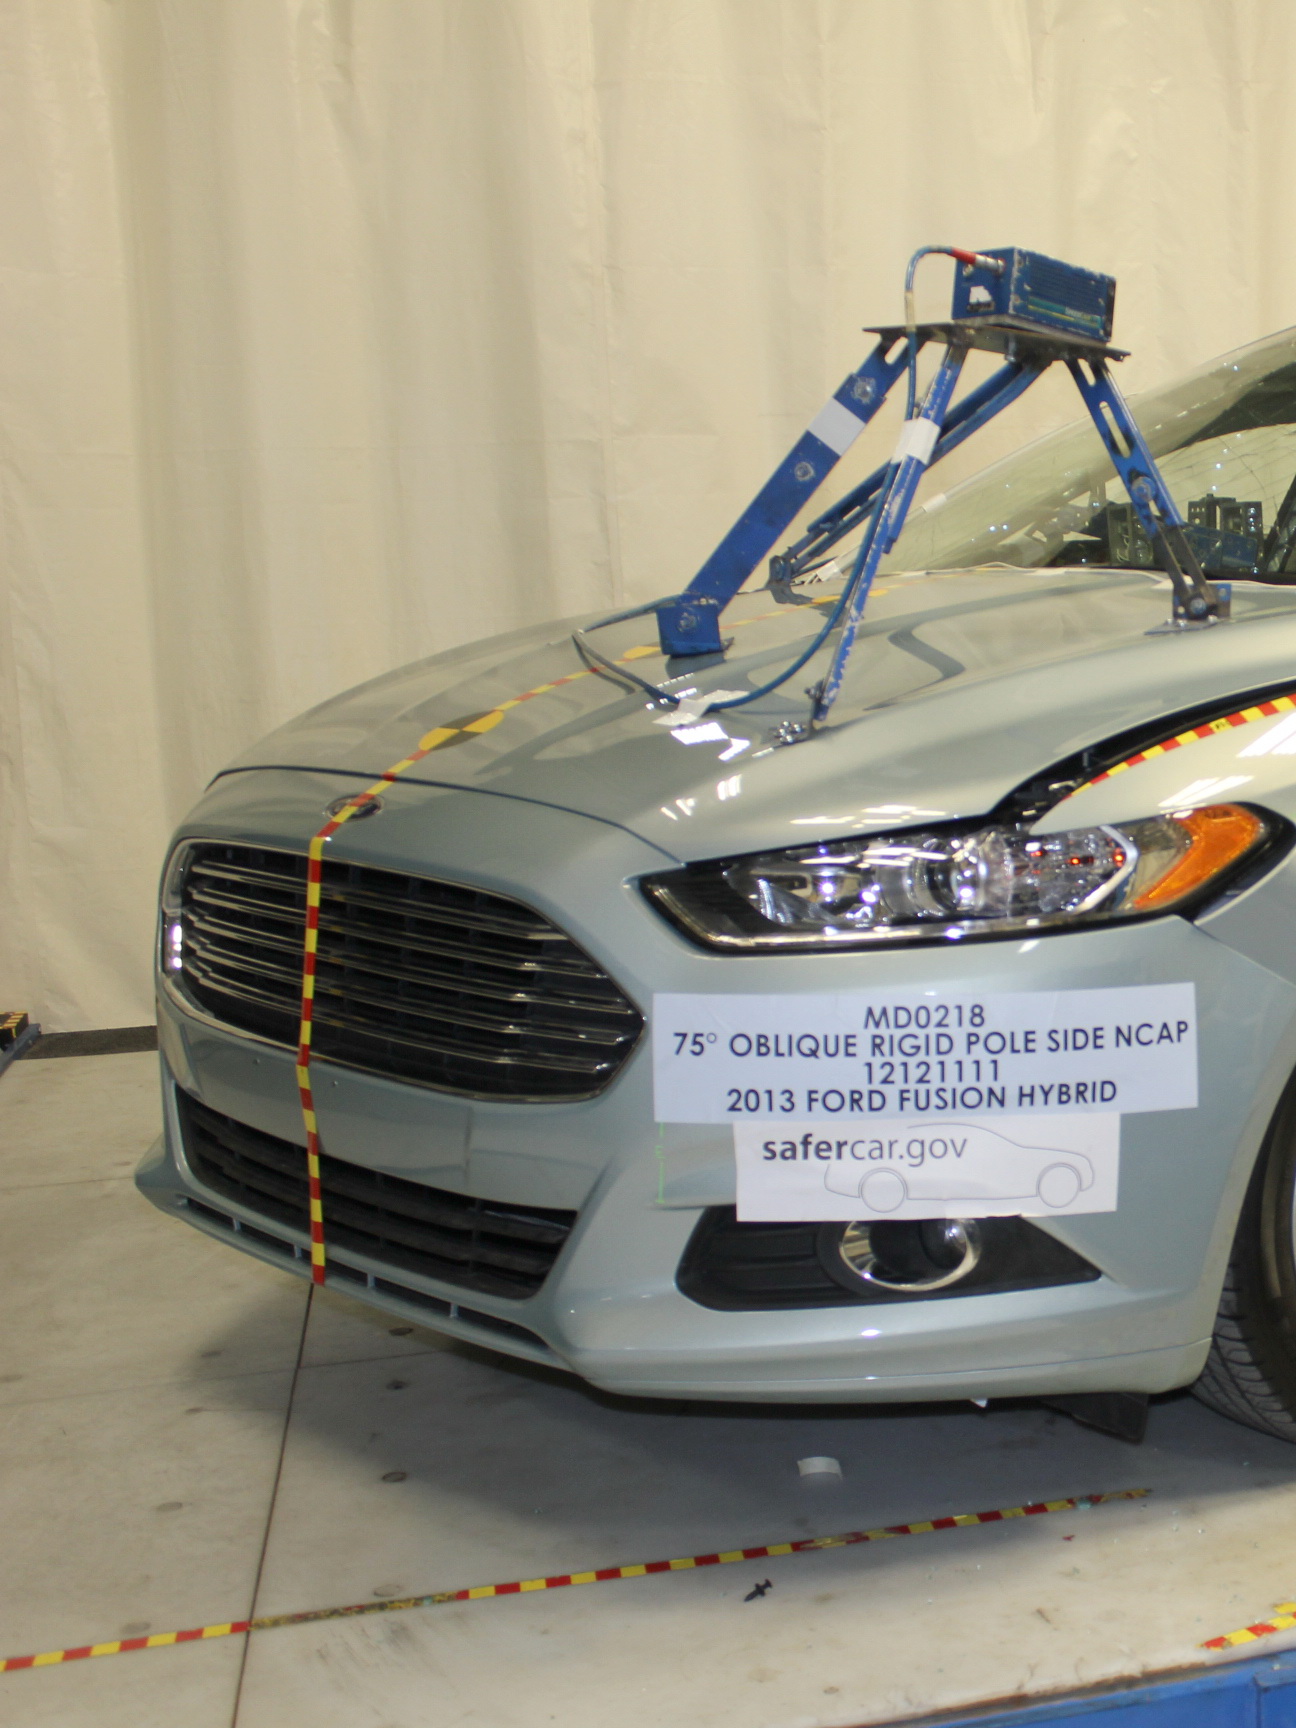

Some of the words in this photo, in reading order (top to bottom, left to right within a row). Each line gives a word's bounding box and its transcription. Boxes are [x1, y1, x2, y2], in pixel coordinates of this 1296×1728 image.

[863, 1003, 987, 1031] MD0218
[728, 1032, 859, 1060] OBLIQUE
[870, 1032, 955, 1058] RIGID
[966, 1029, 1038, 1056] POLE
[1046, 1026, 1106, 1053] SIDE
[1114, 1020, 1190, 1049] NCAP
[864, 1058, 1000, 1086] 12121111
[726, 1088, 796, 1114] 2013
[805, 1088, 887, 1114] FORD
[898, 1085, 1007, 1112] FUSION
[1017, 1079, 1119, 1108] HYBRID
[761, 1132, 969, 1168] safercar.gov
